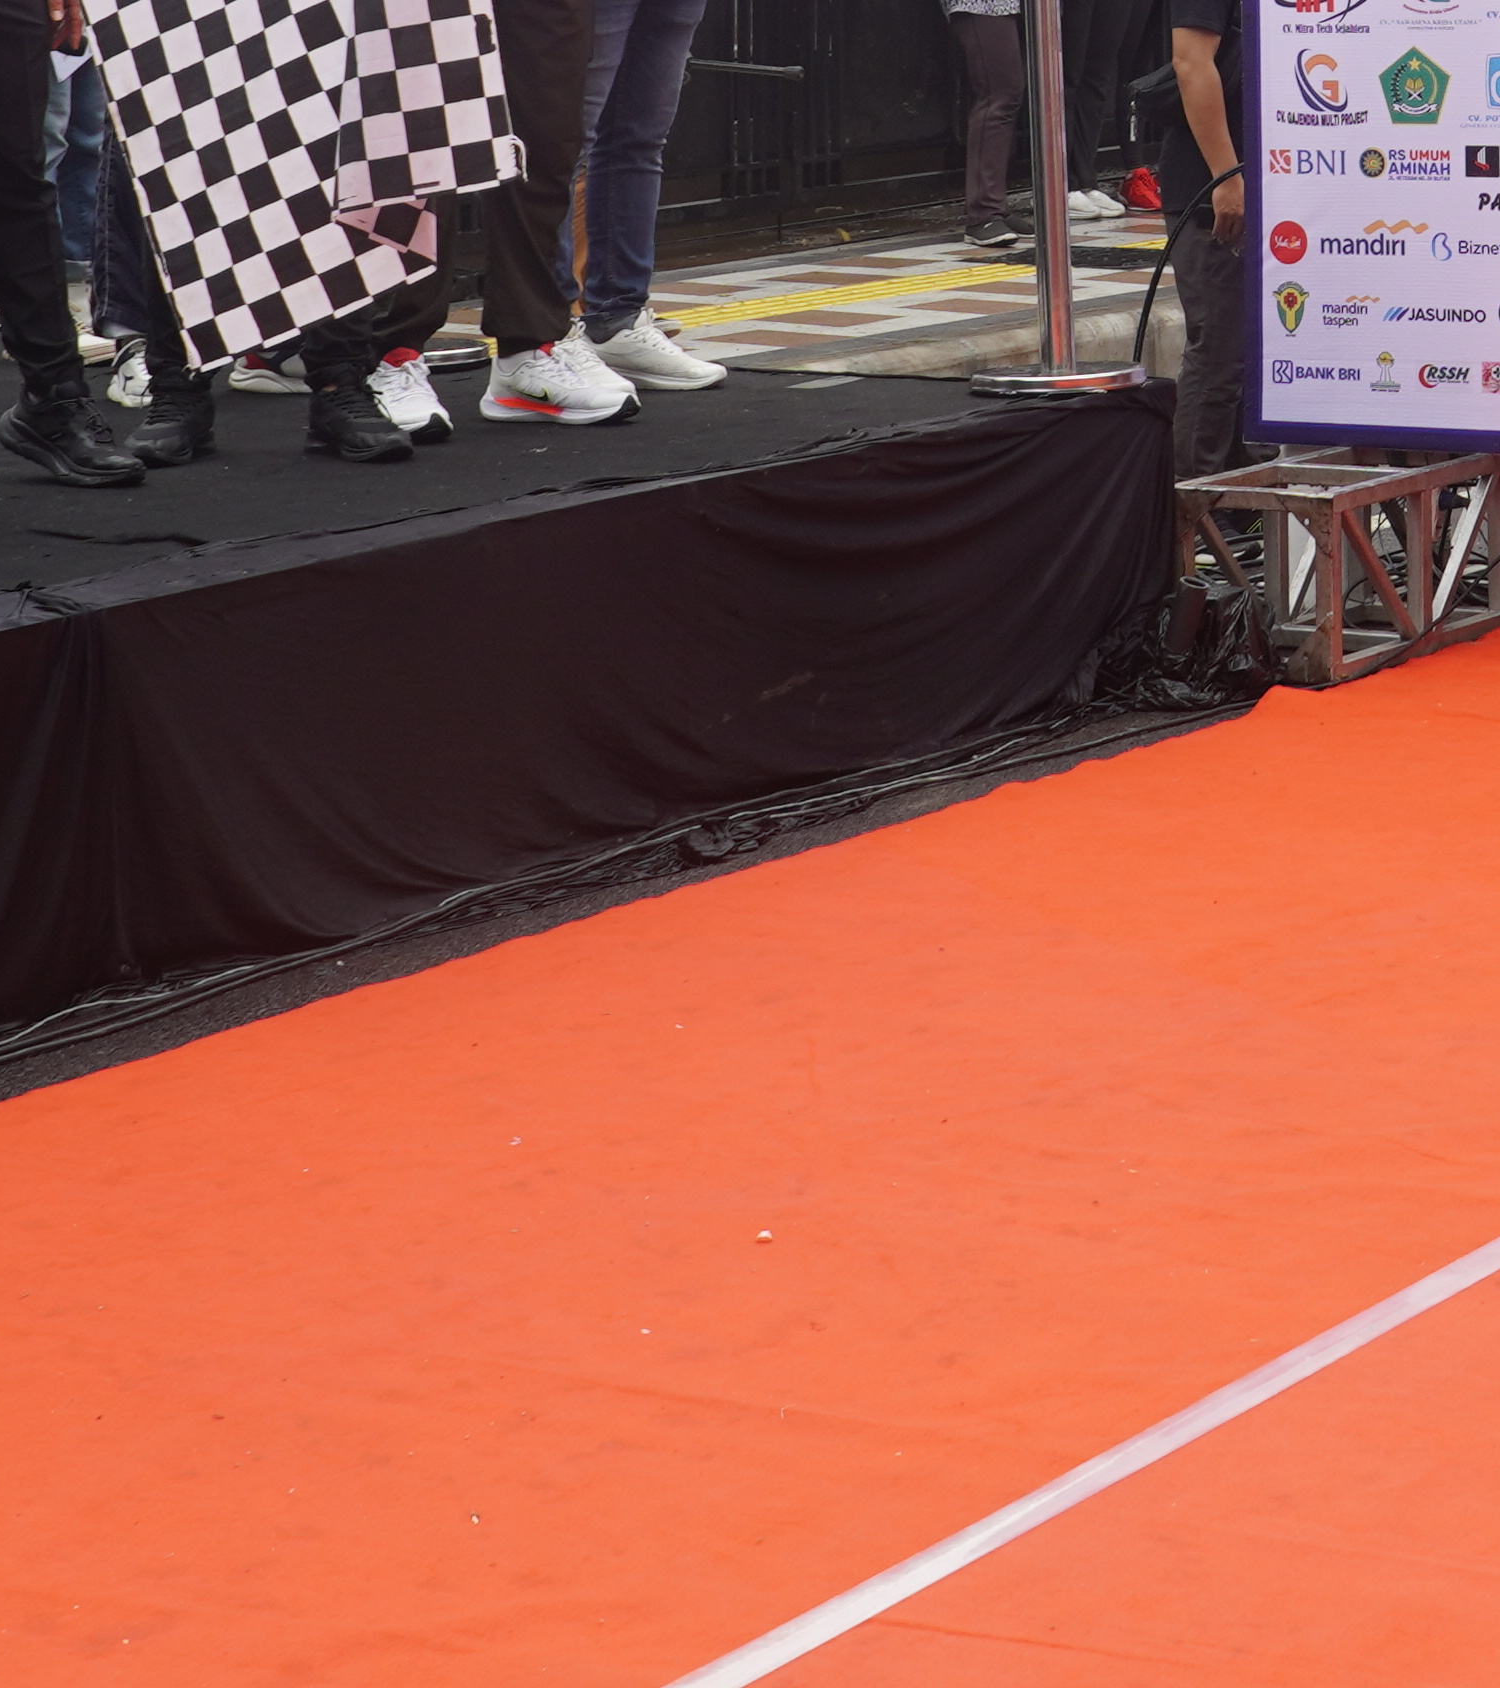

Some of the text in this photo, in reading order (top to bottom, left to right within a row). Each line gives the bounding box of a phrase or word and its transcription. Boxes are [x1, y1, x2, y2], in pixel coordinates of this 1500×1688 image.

[1486, 11, 1500, 19] CV.
[1295, 23, 1314, 33] Mitra
[1316, 24, 1332, 33] Tech
[1276, 110, 1368, 126] CV. GAJENDRA MULTI PROJECT
[1297, 149, 1346, 175] BNI
[1389, 149, 1450, 161] RS UMUM
[1388, 162, 1450, 175] AMINAH
[1320, 234, 1405, 256] mandiri
[1322, 302, 1368, 315] mandiri
[1407, 308, 1486, 323] JASUINDO
[1323, 313, 1359, 328] taspen
[1295, 366, 1360, 381] BANK BRI
[1427, 366, 1470, 381] RSSH
